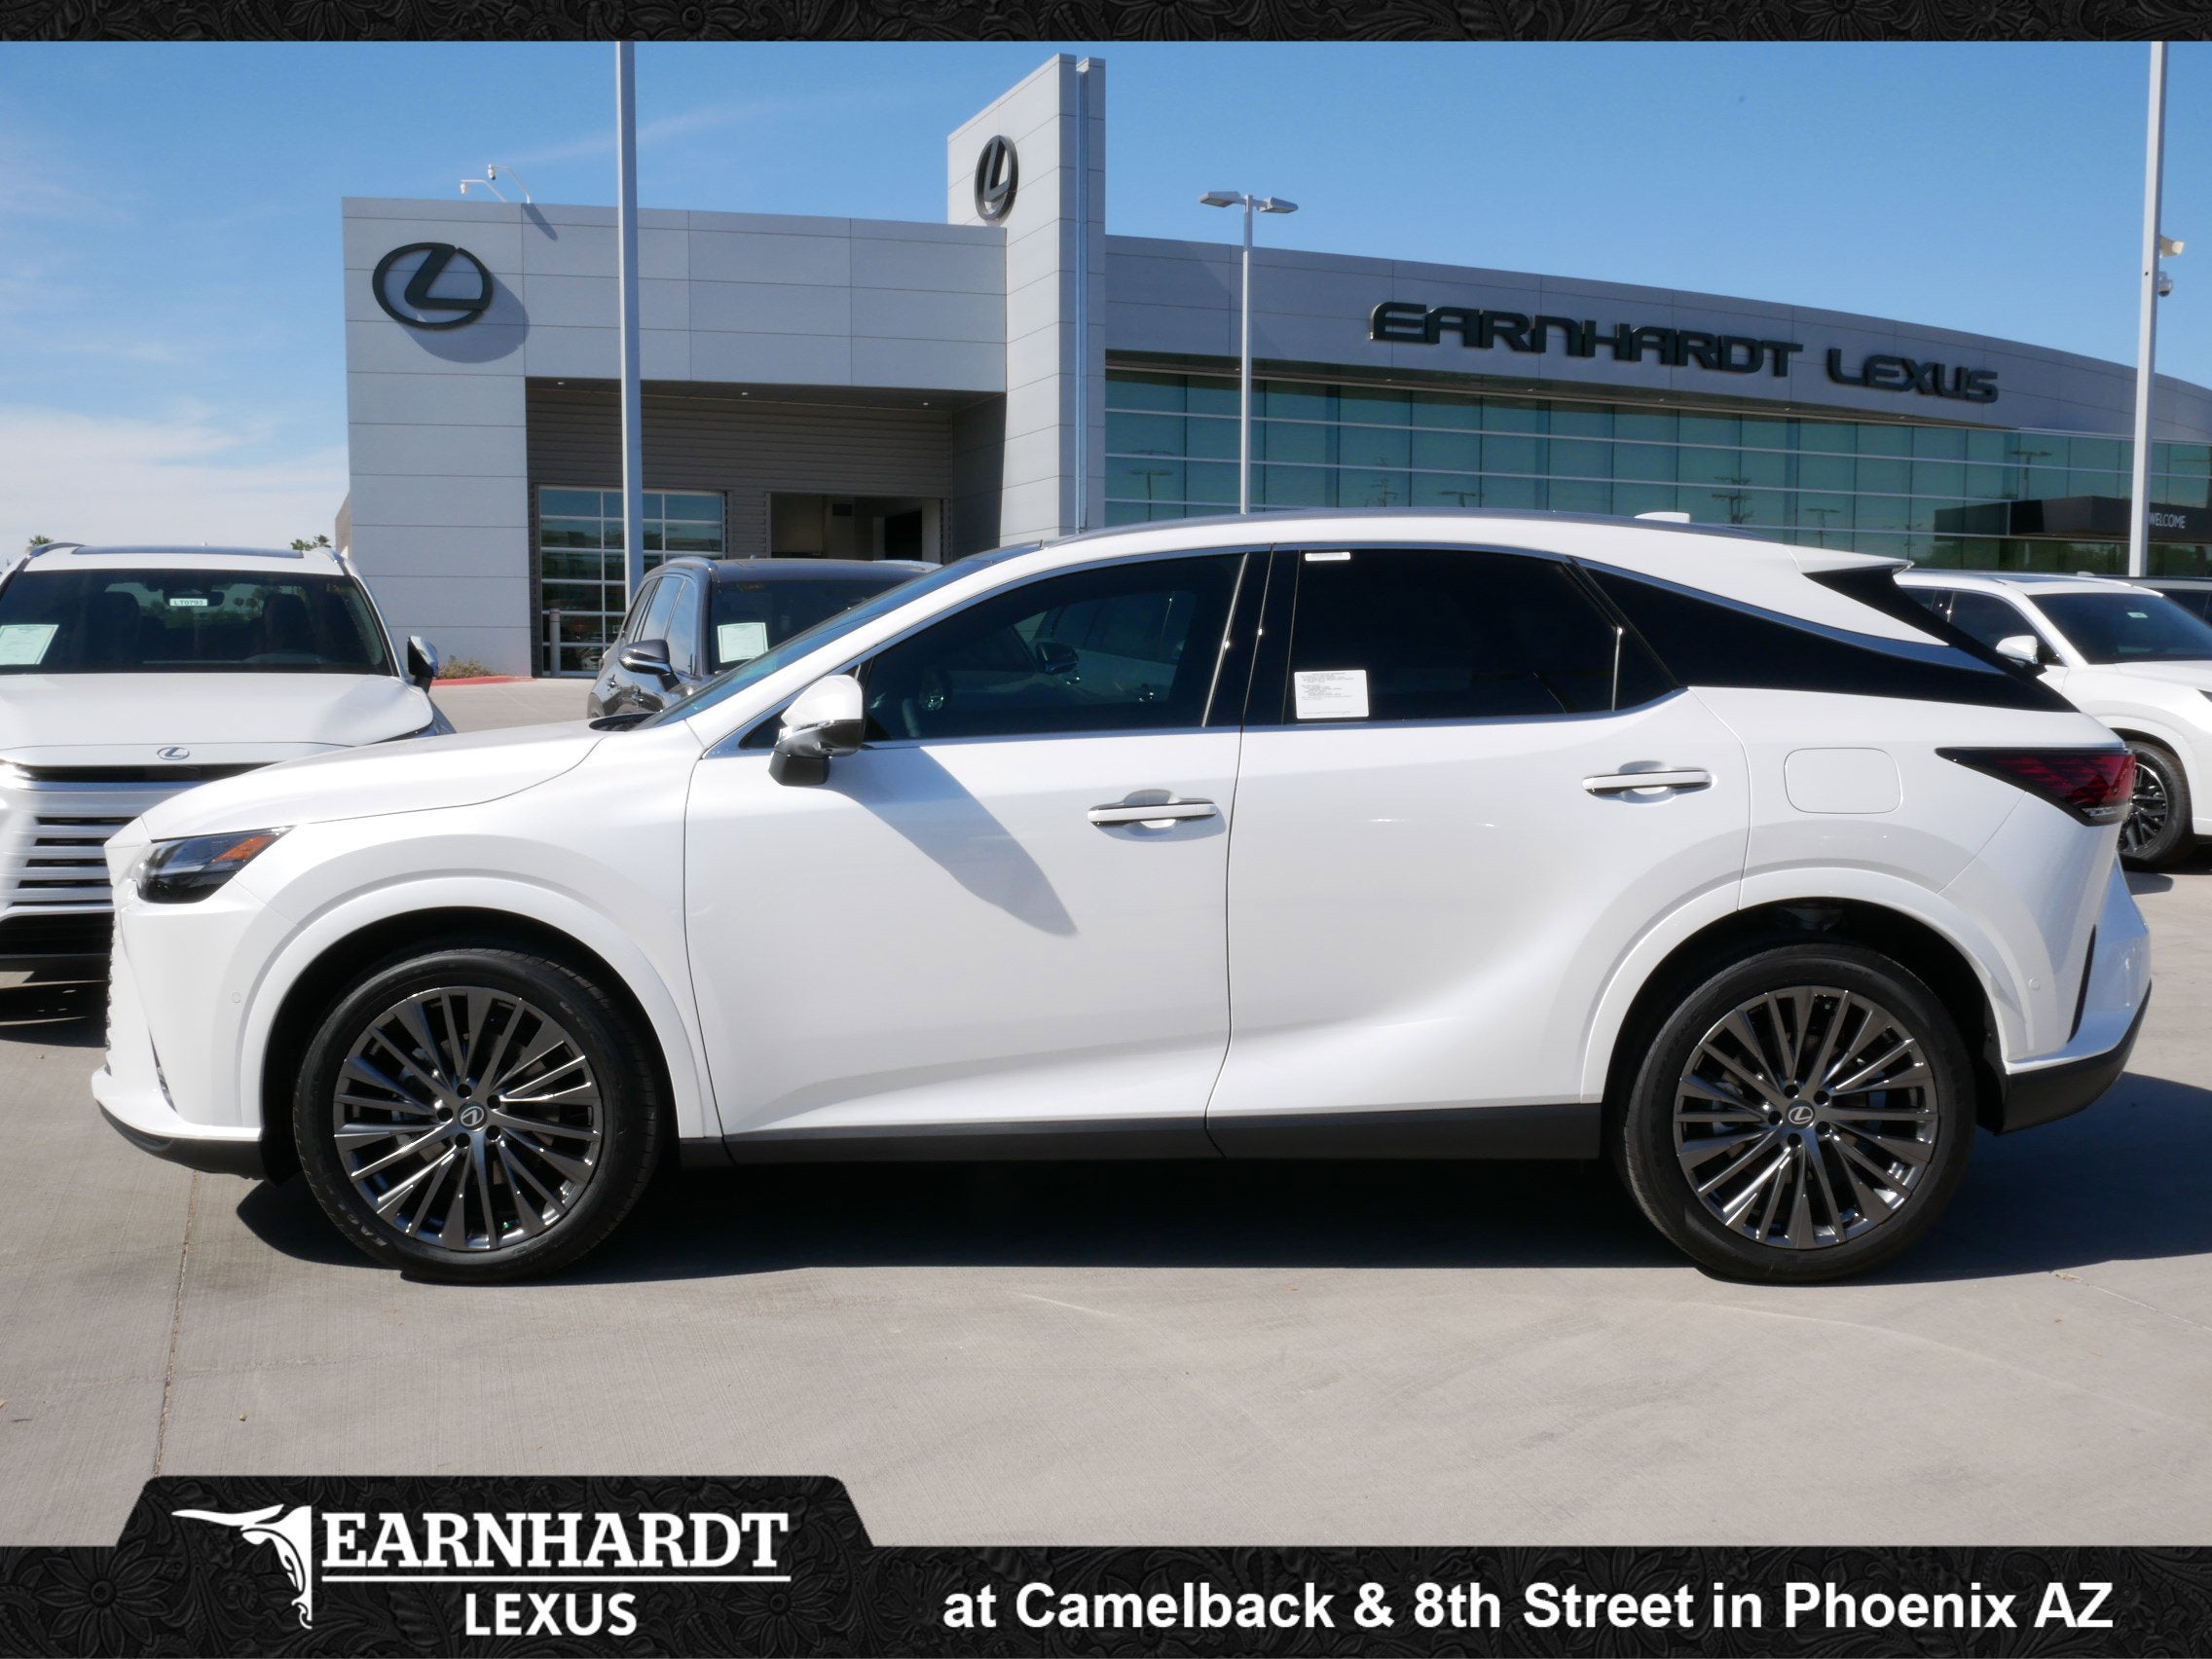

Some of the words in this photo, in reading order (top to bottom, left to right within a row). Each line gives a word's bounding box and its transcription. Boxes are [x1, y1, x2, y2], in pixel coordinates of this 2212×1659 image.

[1370, 301, 1803, 377] EARNHARDT
[1826, 348, 2000, 404] LEXUS
[2149, 512, 2187, 529] WELCOME
